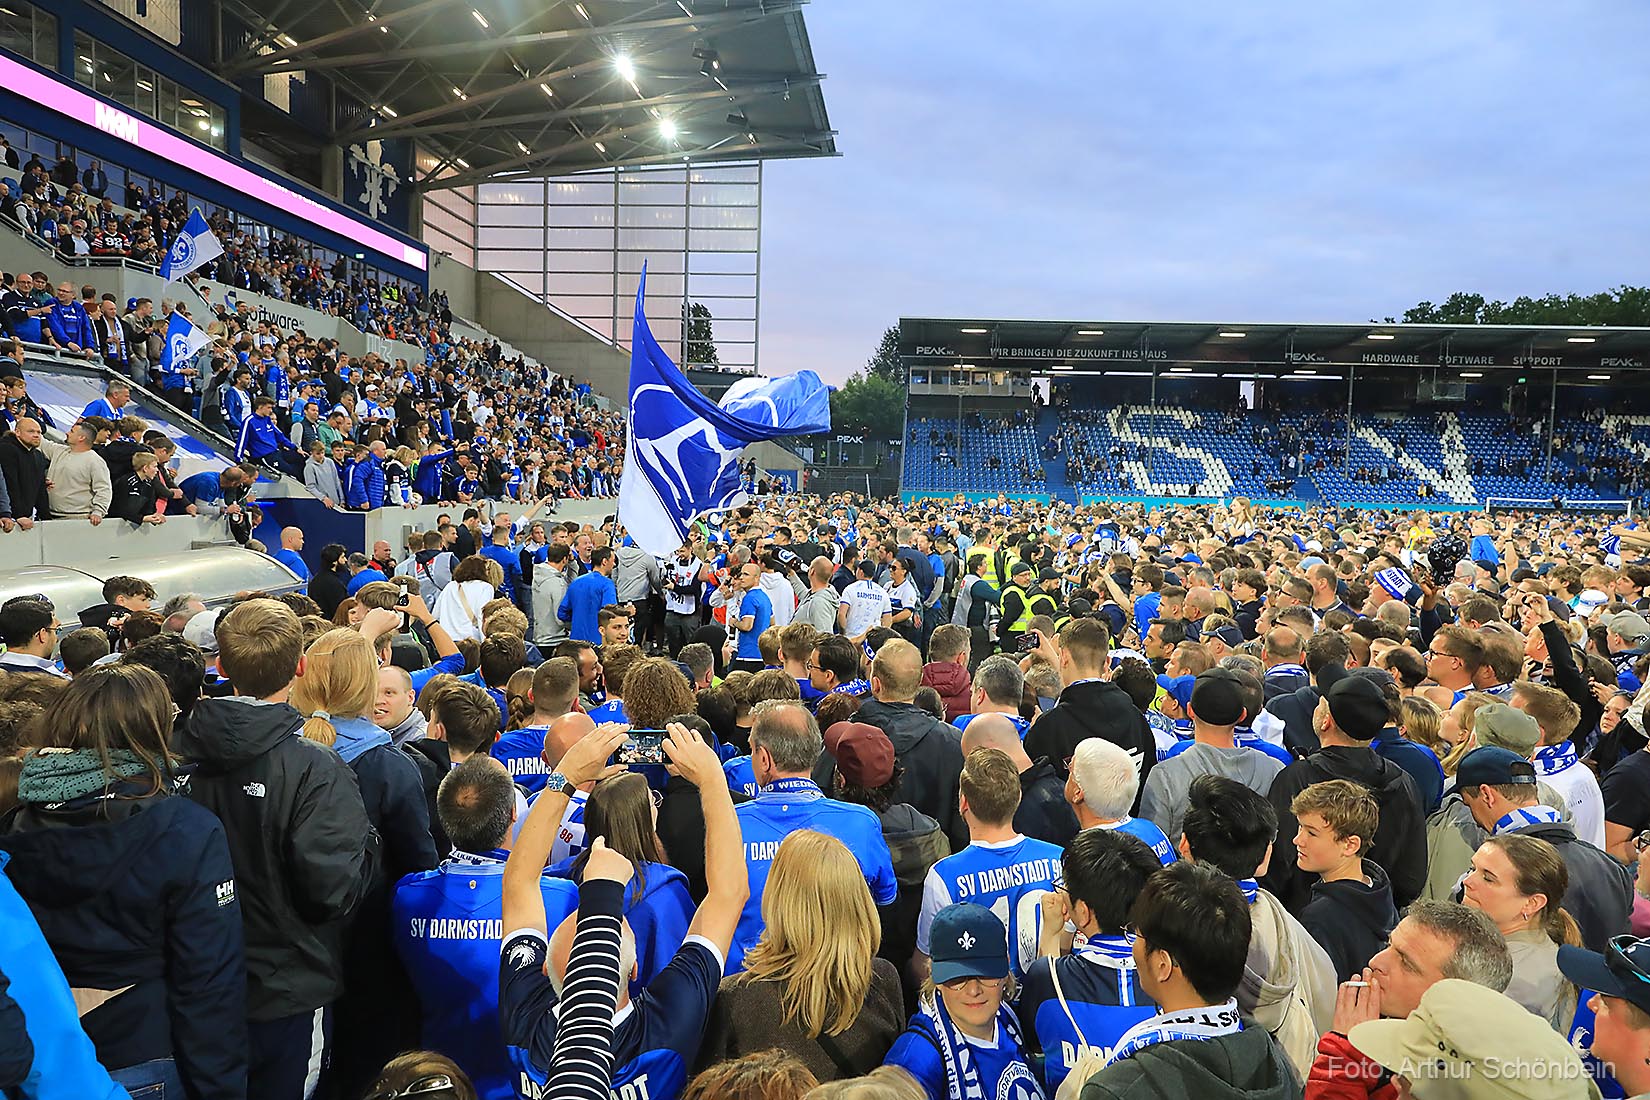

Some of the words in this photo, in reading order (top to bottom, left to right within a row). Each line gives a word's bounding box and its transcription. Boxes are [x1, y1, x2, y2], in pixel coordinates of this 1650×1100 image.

[250, 305, 300, 332] oftware
[916, 346, 946, 355] PEAK
[1011, 348, 1054, 357] BRINGEN
[1056, 348, 1072, 357] DIE
[1074, 349, 1119, 358] ZUKUNFT
[1122, 350, 1138, 359] INS
[1362, 354, 1420, 363] HARDWARE
[1600, 358, 1634, 367] PEAK
[836, 435, 864, 444] PEAK
[560, 828, 573, 843] 98
[956, 874, 976, 898] SV
[978, 858, 1052, 894] DARMSTADT
[216, 879, 234, 899] HH
[410, 917, 426, 938] SV
